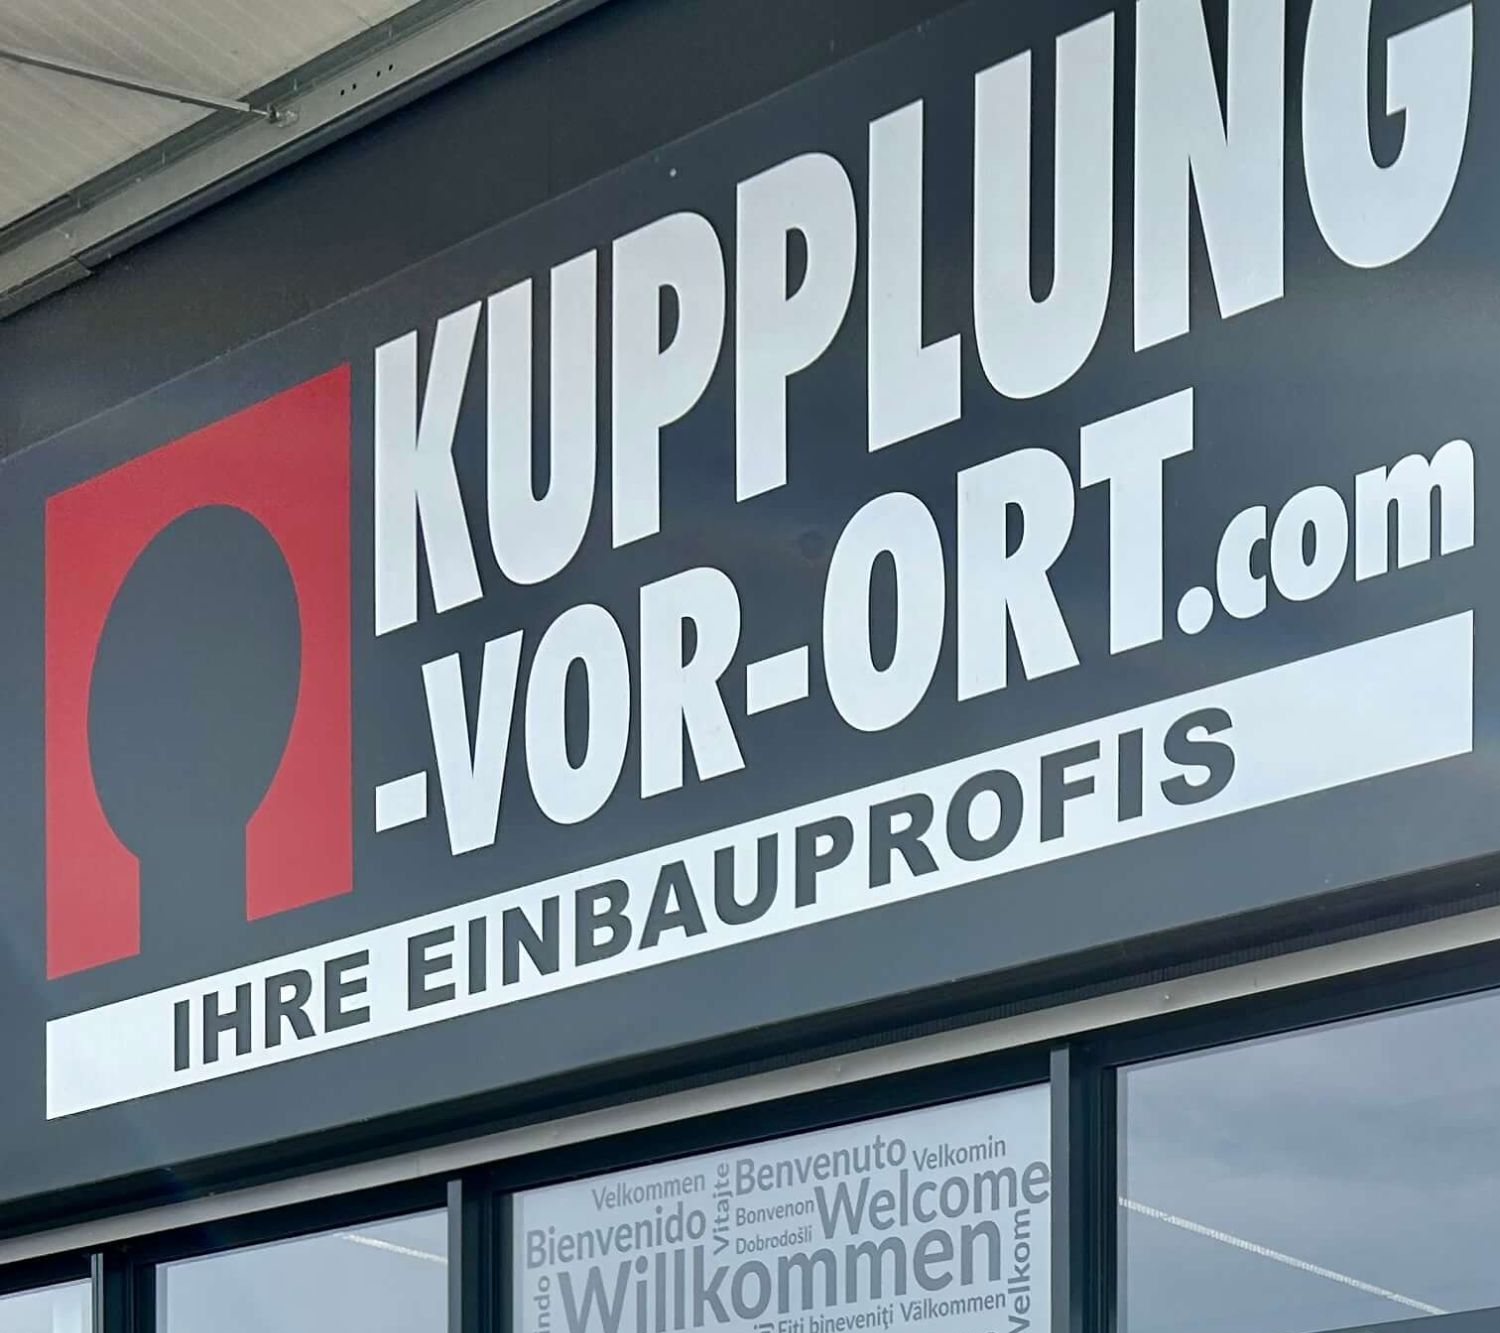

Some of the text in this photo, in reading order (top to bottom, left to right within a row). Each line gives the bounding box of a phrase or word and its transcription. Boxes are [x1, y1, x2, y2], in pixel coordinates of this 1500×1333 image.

[374, 0, 1474, 637] KUPPLUNG
[374, 387, 1475, 856] -VOR-ORT.com
[172, 706, 1237, 1073] IHRE EINBAUPROFIS
[735, 1134, 906, 1196] Benvenuto
[912, 1135, 1006, 1172] Velkomin
[592, 1174, 706, 1212] Velkommen
[713, 1162, 734, 1256] Vitajte
[736, 1199, 815, 1227] Bonvenon
[814, 1161, 1051, 1240] Welcome
[526, 1201, 707, 1270] Bienvenido
[736, 1225, 813, 1255] Dobrodošli
[900, 1292, 1007, 1323] Välkommen
